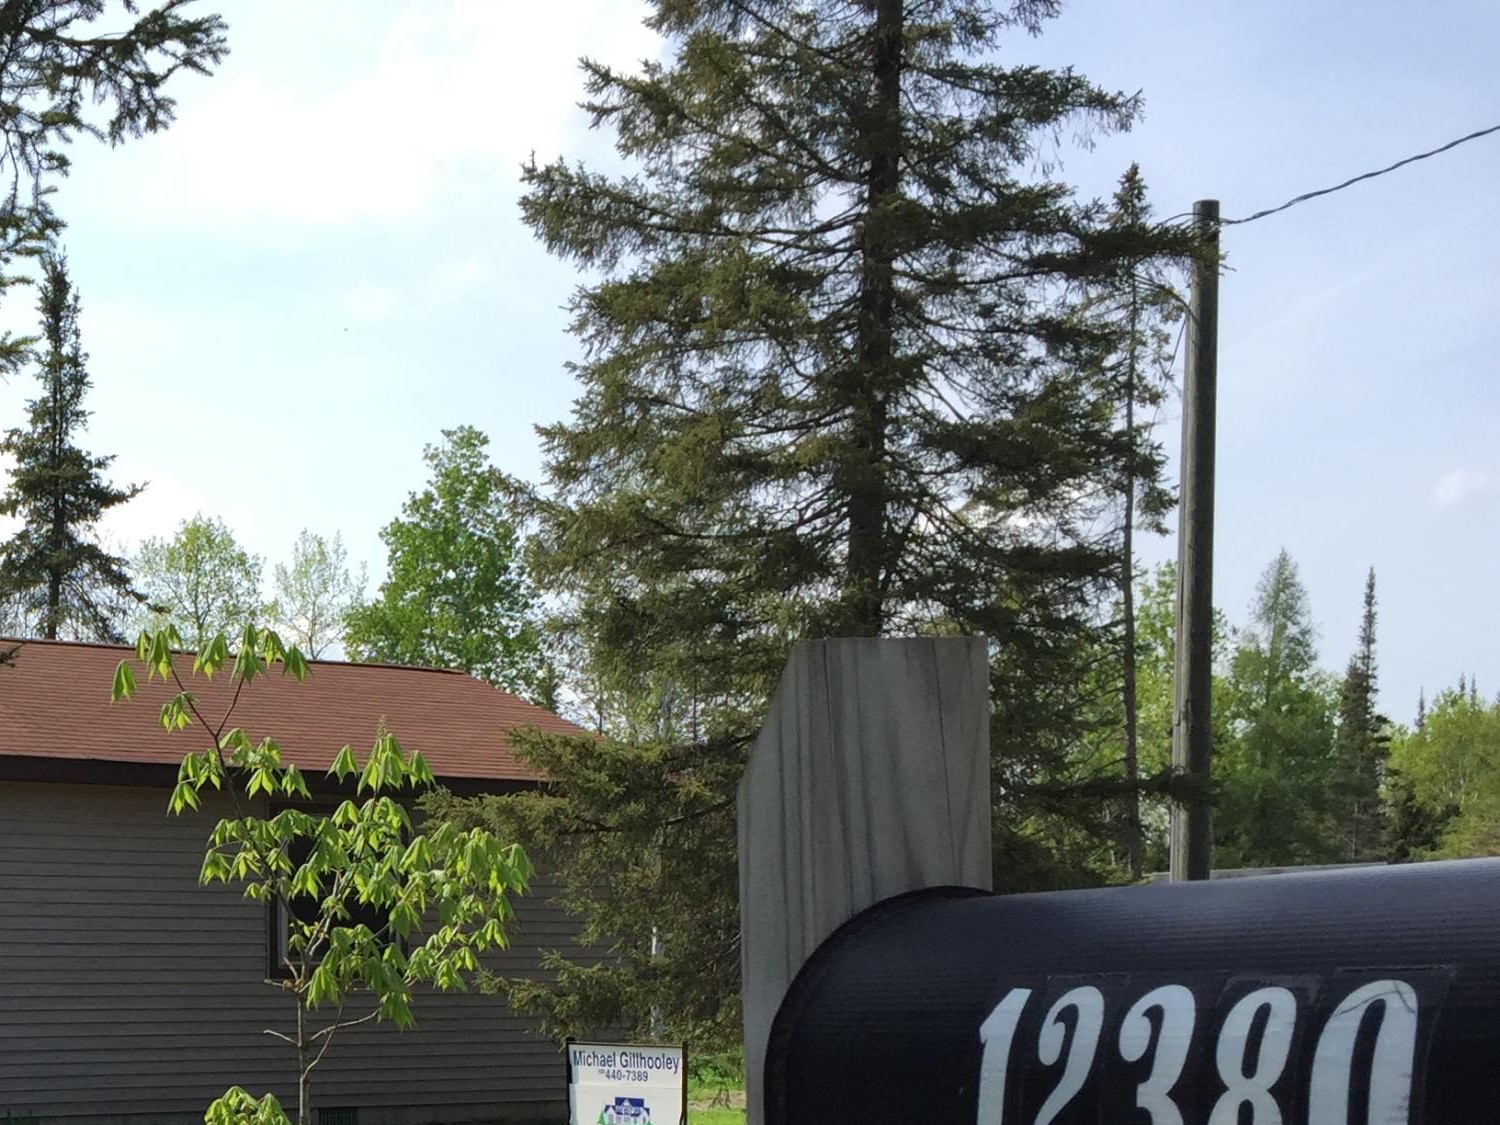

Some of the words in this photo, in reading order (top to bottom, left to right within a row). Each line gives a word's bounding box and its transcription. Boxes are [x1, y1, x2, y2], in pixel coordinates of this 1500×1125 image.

[573, 1050, 616, 1068] Michael
[619, 1051, 679, 1075] Gillhooley
[605, 1069, 648, 1082] 440-7389
